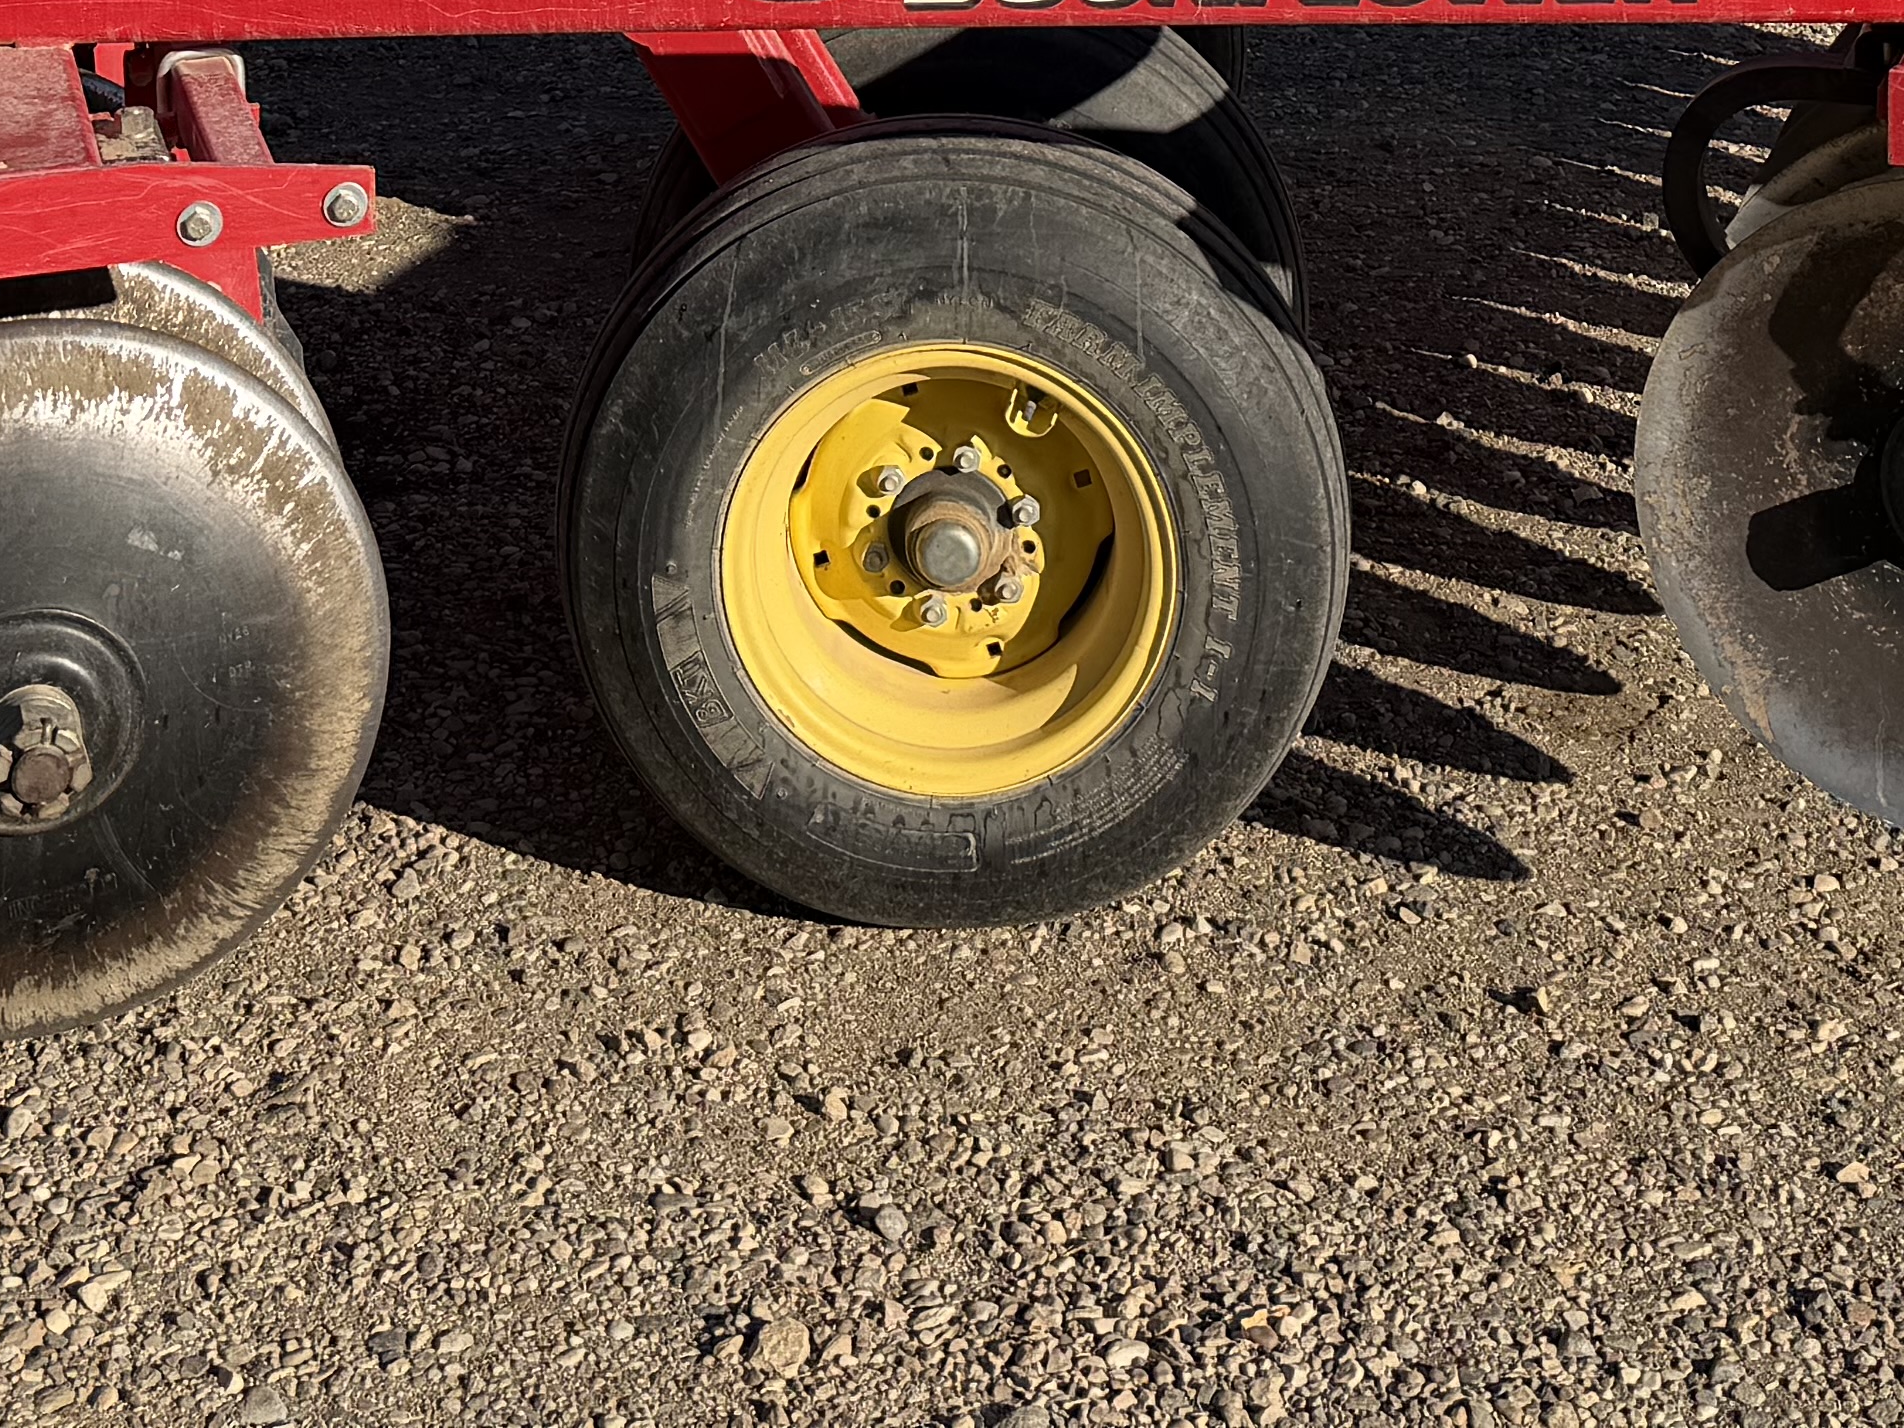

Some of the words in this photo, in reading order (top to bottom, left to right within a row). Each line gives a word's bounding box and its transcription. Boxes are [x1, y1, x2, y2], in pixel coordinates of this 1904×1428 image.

[1022, 298, 1146, 389] FARM
[1132, 372, 1243, 622] IMPLEMENT
[673, 656, 729, 723] BKT
